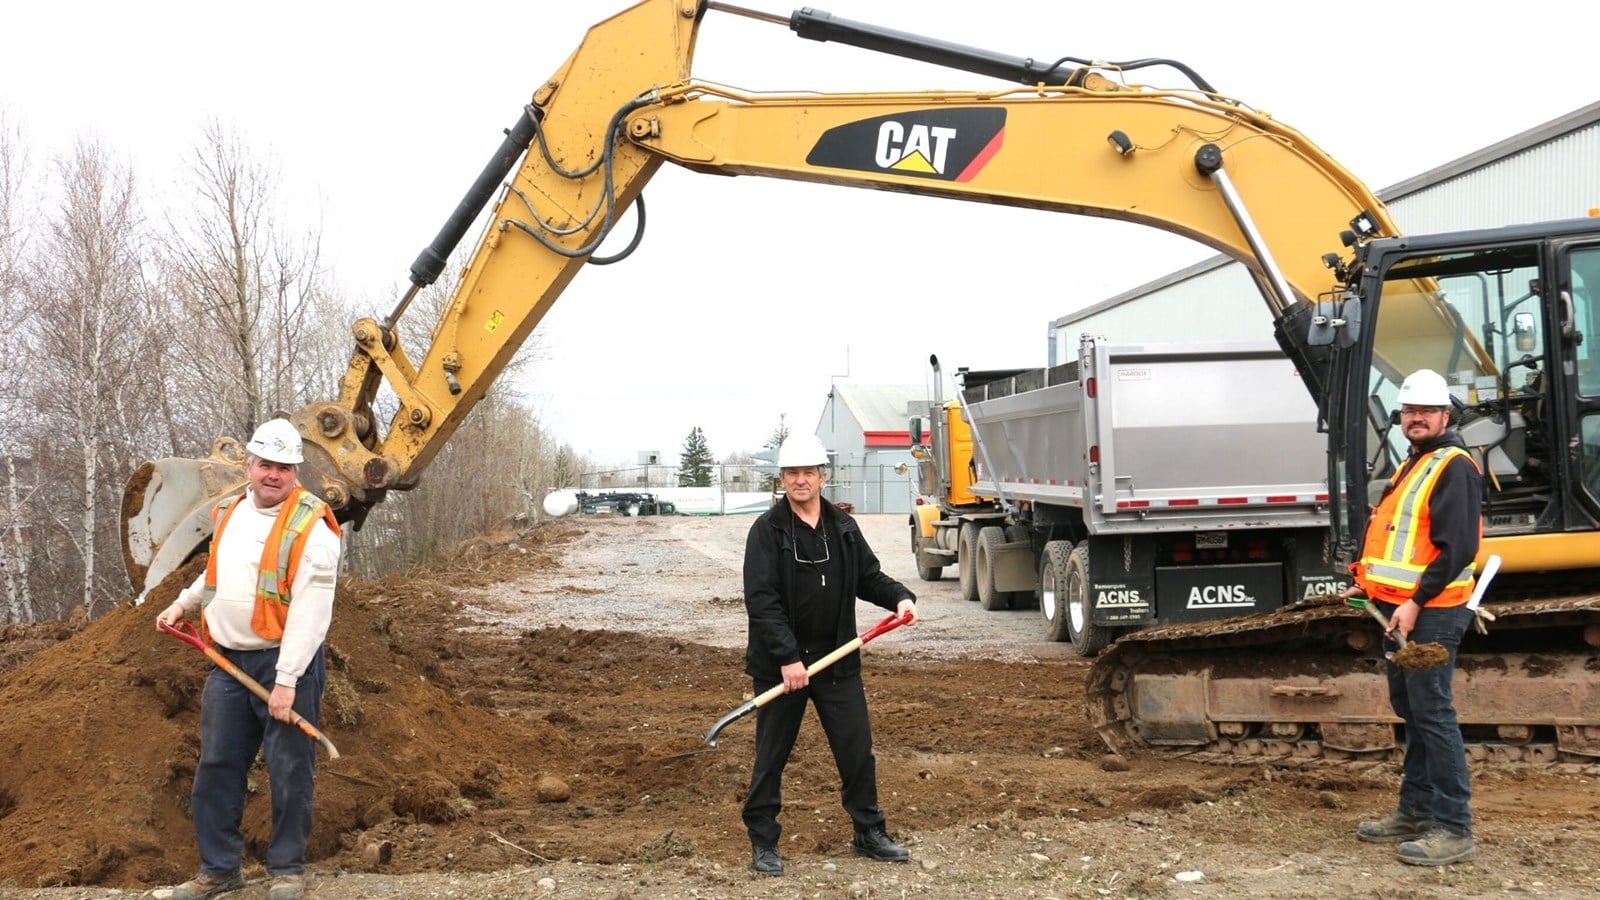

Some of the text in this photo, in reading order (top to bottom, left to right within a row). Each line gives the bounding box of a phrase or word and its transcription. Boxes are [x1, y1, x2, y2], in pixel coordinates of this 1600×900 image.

[875, 120, 957, 174] CAT
[1095, 590, 1140, 609] ACNS
[1187, 584, 1246, 609] ACNS
[1303, 581, 1348, 600] ACNS
